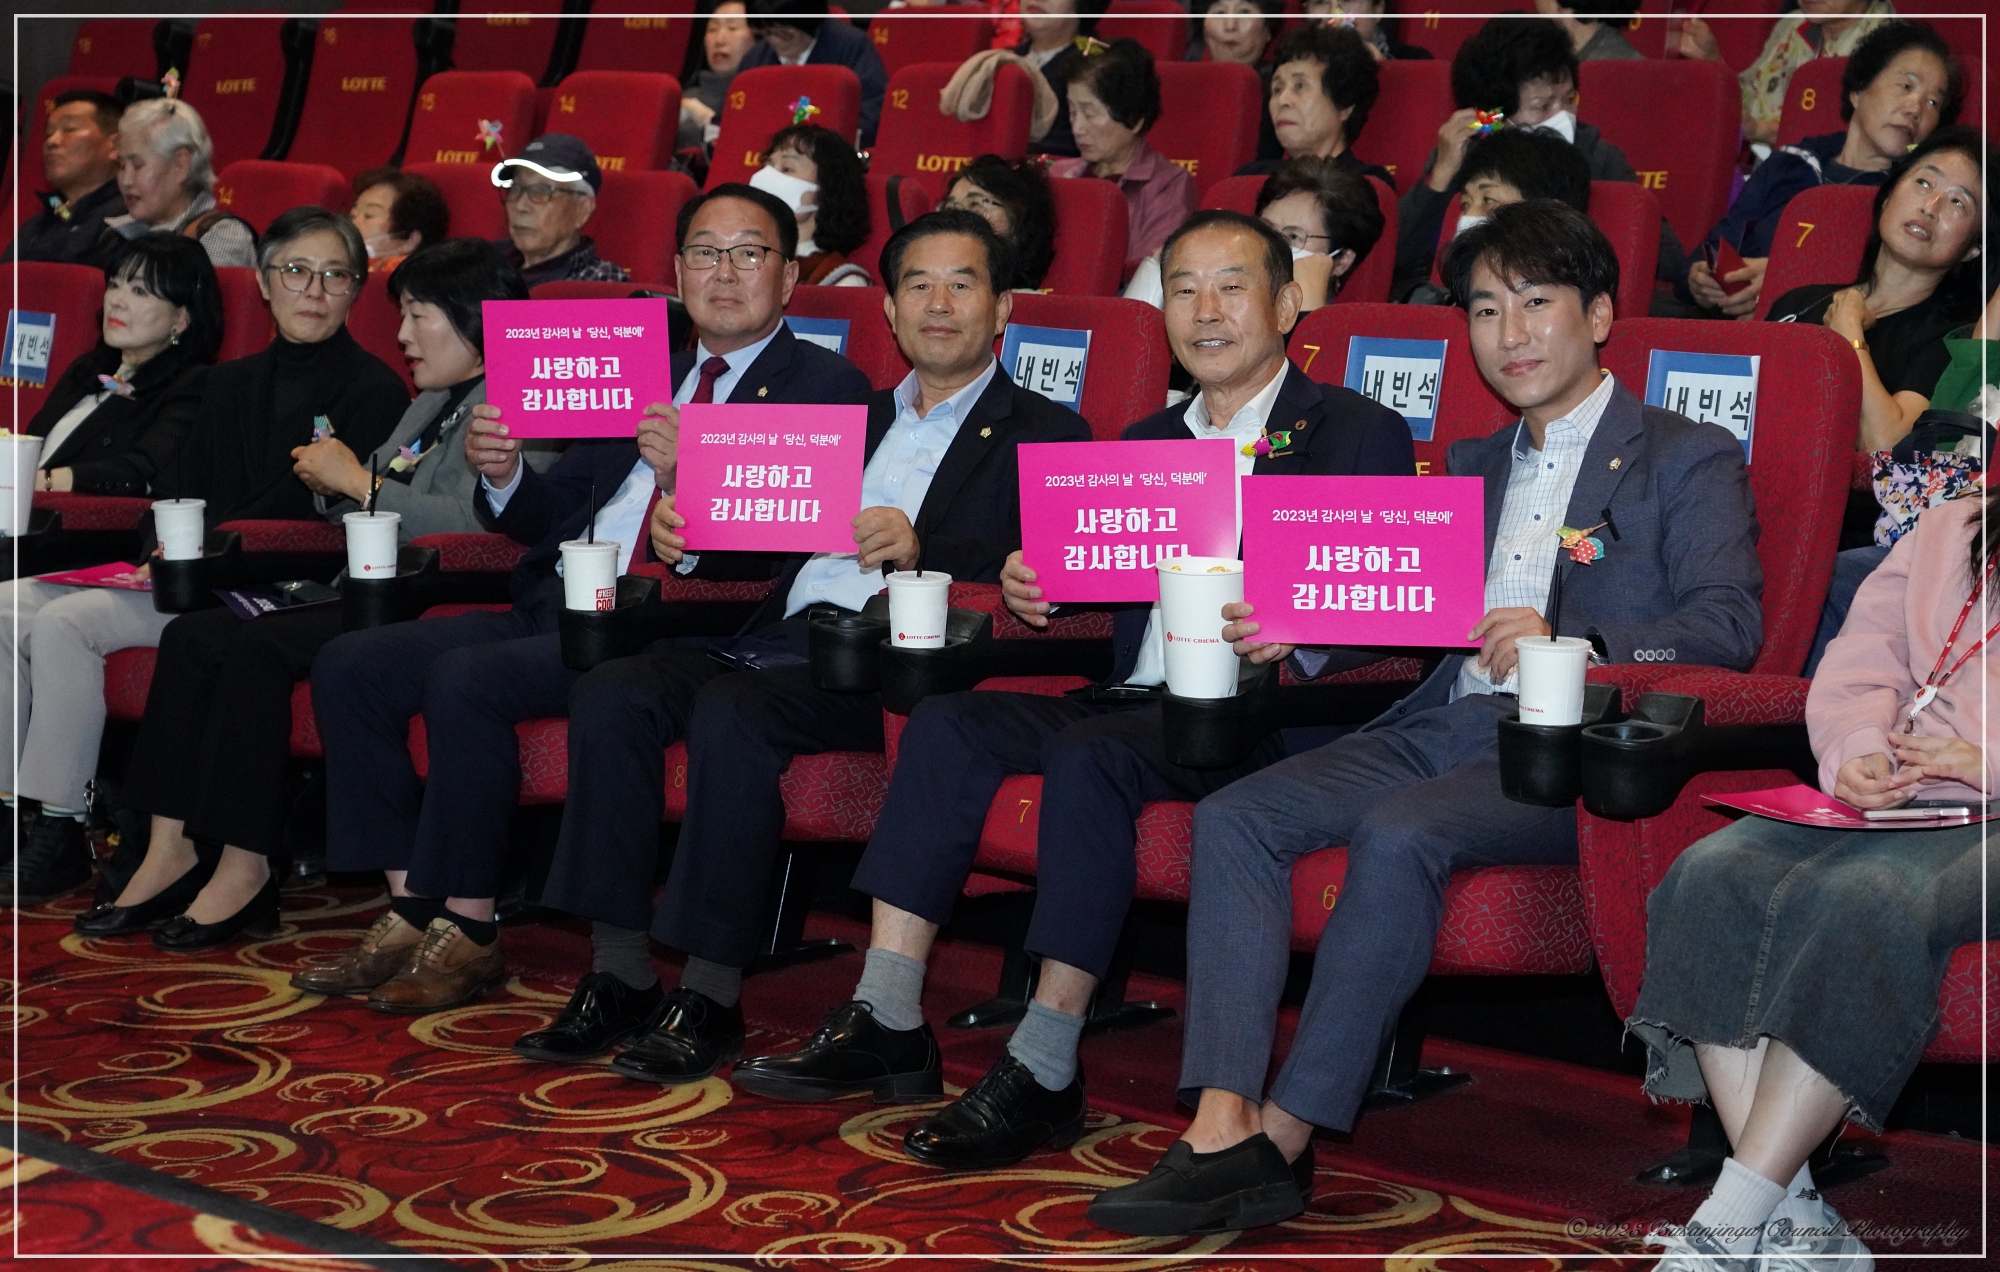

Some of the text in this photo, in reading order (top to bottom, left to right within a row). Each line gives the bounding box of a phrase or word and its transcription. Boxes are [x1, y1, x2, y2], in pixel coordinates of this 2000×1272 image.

[891, 89, 910, 110] 12
[1802, 88, 1817, 111] 8
[1796, 222, 1815, 248] 7
[505, 328, 540, 340] 2023년
[541, 327, 570, 339] 감사의
[572, 327, 582, 339] 날
[530, 356, 622, 380] 사랑하고
[1303, 344, 1320, 373] 7
[1016, 356, 1081, 394] 내빈석
[521, 388, 634, 411] 감사합니다
[1363, 369, 1437, 410] 내빈석
[700, 433, 736, 445] 2023년
[737, 433, 766, 445] 감사의
[768, 433, 778, 446] 날
[721, 464, 812, 488] 사랑하고
[1045, 474, 1085, 488] 2023년
[1087, 473, 1120, 487] 감사의
[1122, 473, 1134, 487] 날
[710, 498, 822, 523] 감사합니다
[1074, 507, 1178, 534] 사랑하고
[1272, 509, 1318, 523] 2023년
[1321, 509, 1357, 523] 감사의
[1360, 509, 1373, 523] 날
[1305, 545, 1422, 572] 사랑하고
[1292, 584, 1436, 612] 감사합니다
[675, 765, 685, 788] 8
[1019, 799, 1033, 824] 7
[1323, 884, 1337, 910] 6
